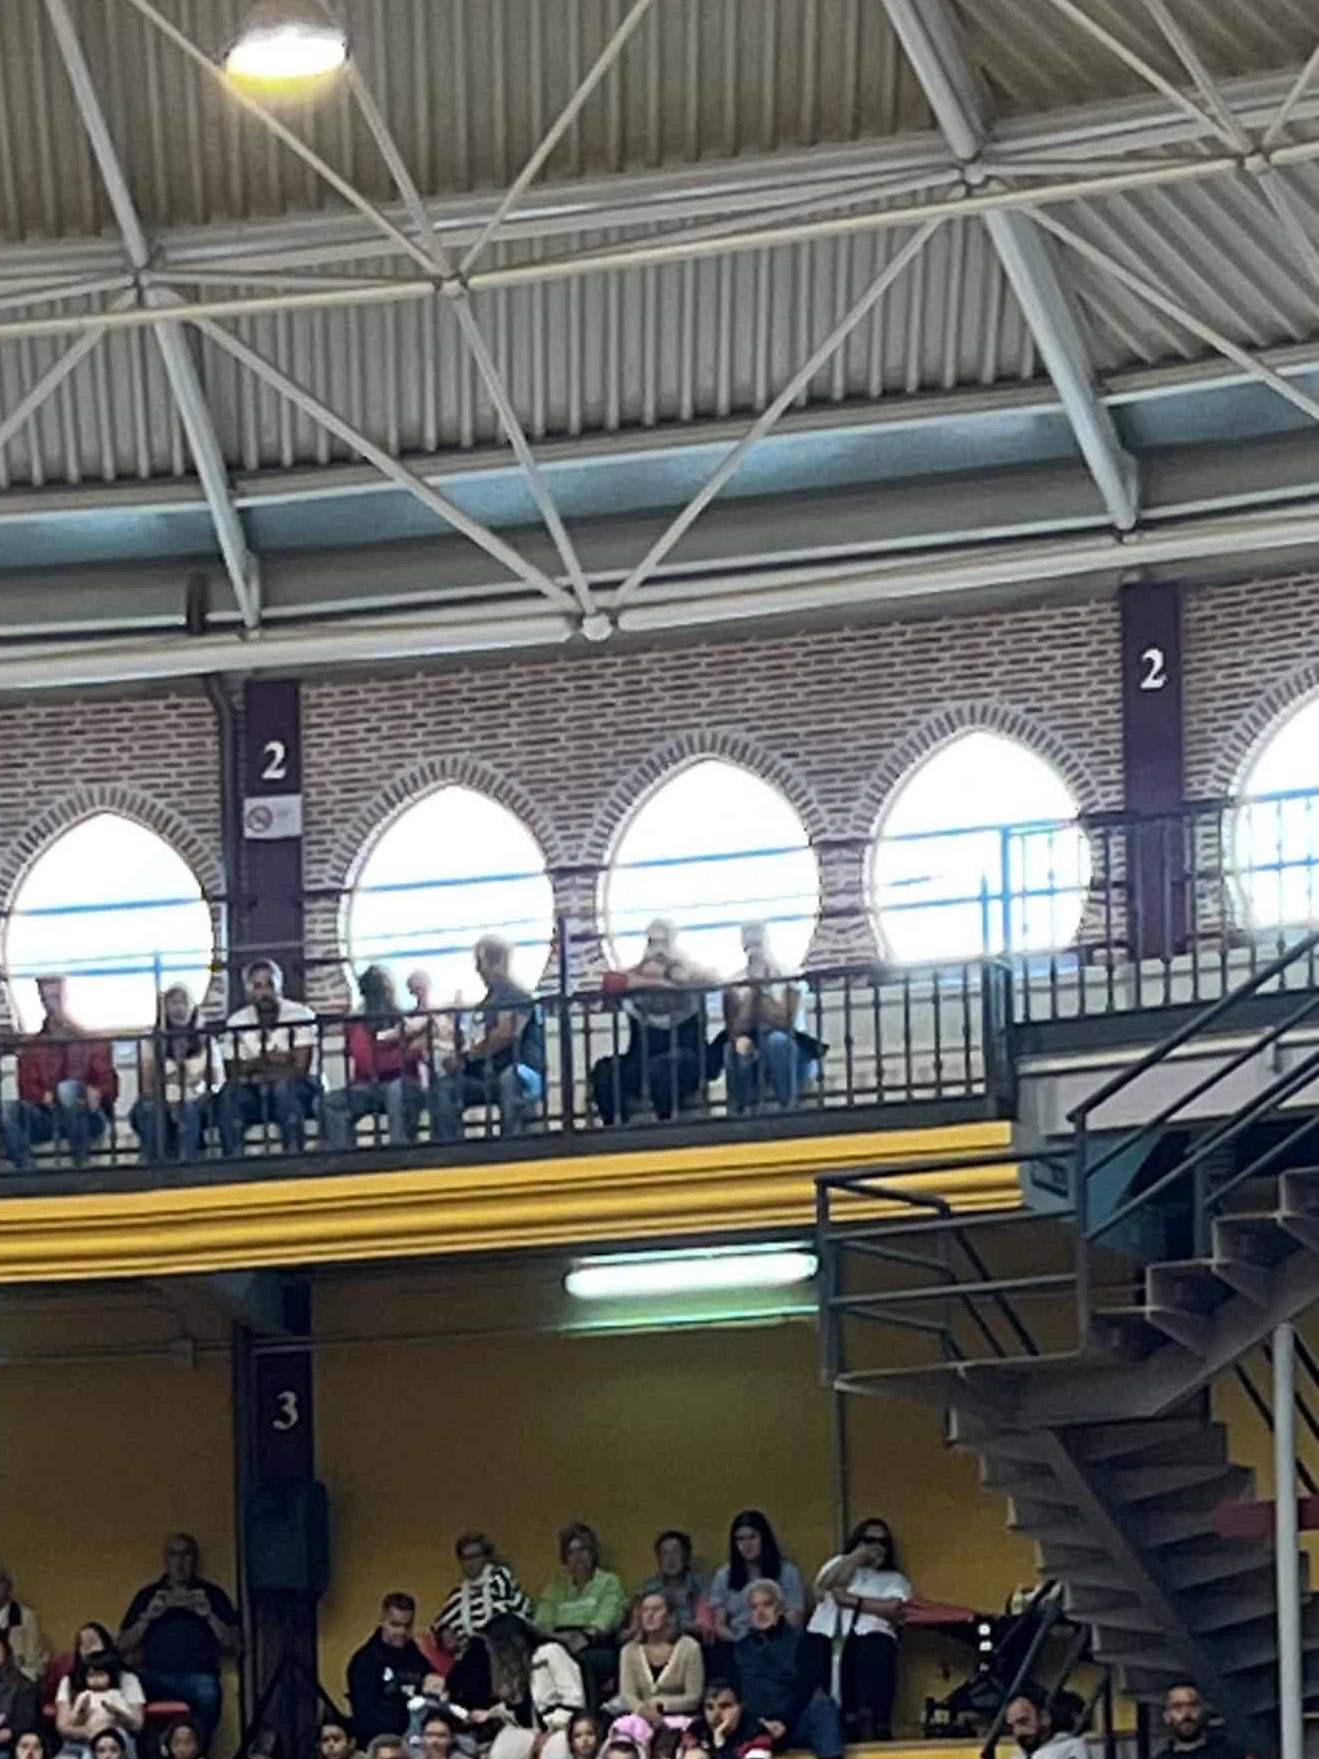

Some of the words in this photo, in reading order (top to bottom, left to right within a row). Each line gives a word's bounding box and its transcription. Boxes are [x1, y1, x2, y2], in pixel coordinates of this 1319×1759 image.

[1140, 647, 1168, 690] 2
[261, 739, 287, 780] 2
[273, 1390, 299, 1431] 3
